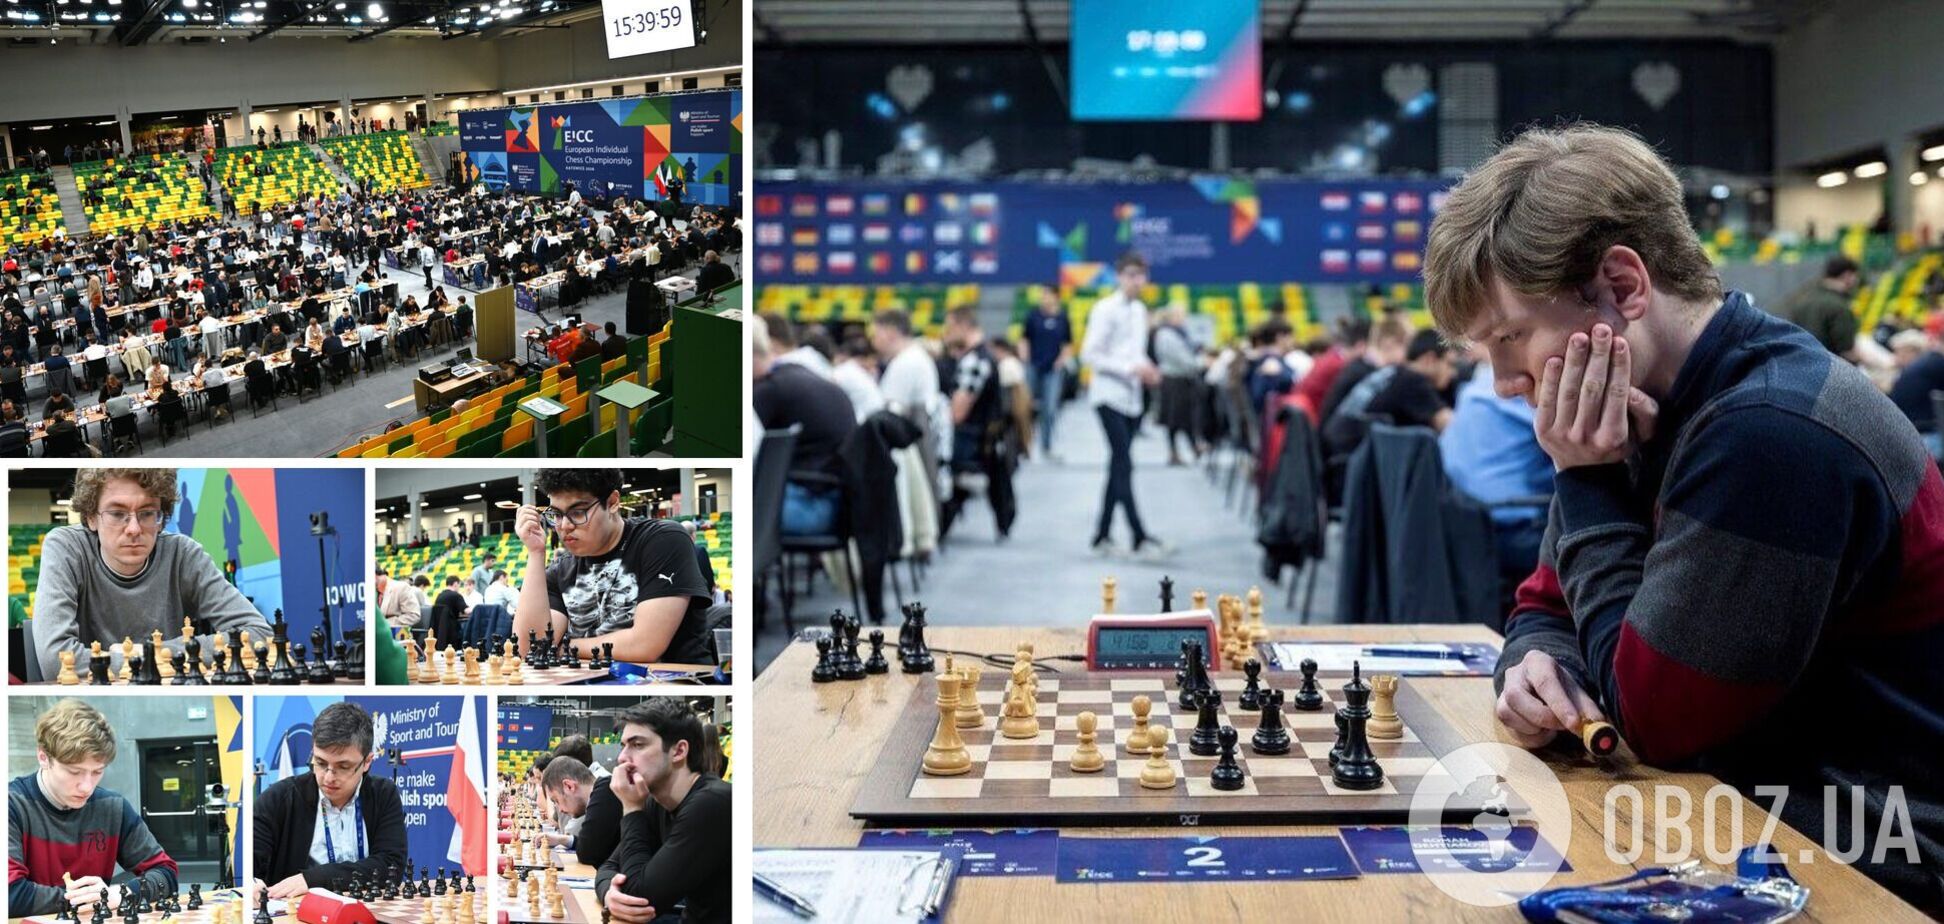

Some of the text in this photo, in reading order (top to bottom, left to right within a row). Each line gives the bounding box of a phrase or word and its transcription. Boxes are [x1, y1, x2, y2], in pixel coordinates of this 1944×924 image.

[613, 5, 682, 38] 15:39:59
[565, 145, 629, 154] European Individual
[565, 155, 633, 167] Chess Championship
[390, 701, 440, 726] Ministry of
[390, 728, 413, 747] Sport
[414, 722, 433, 741] and
[406, 769, 436, 788] make
[400, 789, 421, 807] lish
[1183, 847, 1225, 867] 2
